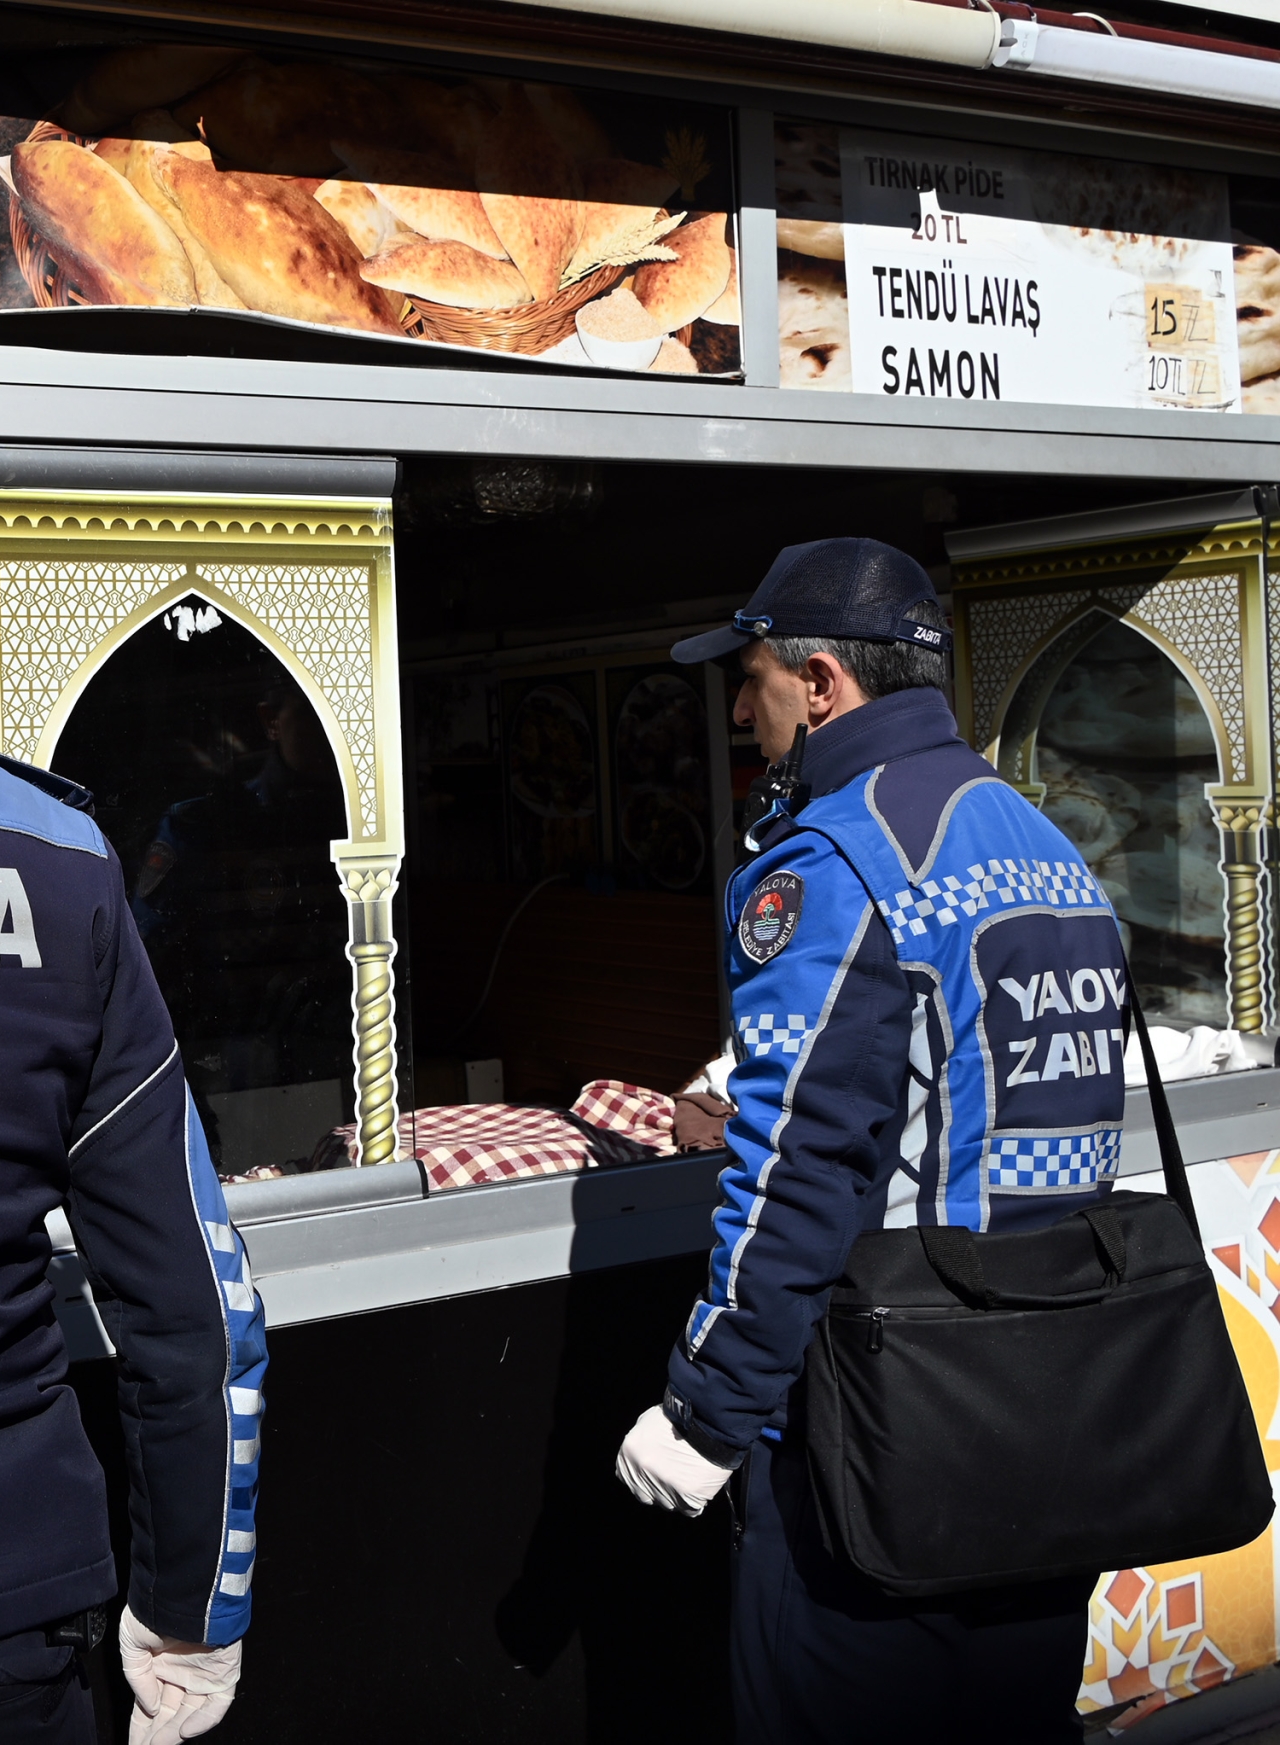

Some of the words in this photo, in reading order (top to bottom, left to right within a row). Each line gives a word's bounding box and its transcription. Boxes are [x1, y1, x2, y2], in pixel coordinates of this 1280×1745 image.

[864, 156, 949, 194] TIRNAK
[954, 160, 1005, 200] PİDE
[910, 211, 937, 242] 20
[940, 214, 968, 245] TL
[872, 260, 957, 323] TENDÜ
[964, 274, 1041, 338] LAVAŞ
[1150, 296, 1178, 336] 15
[881, 345, 1001, 400] SAMON
[913, 625, 943, 646] ZABITA
[754, 877, 796, 897] YALOVA
[765, 912, 796, 955] ZABITASI
